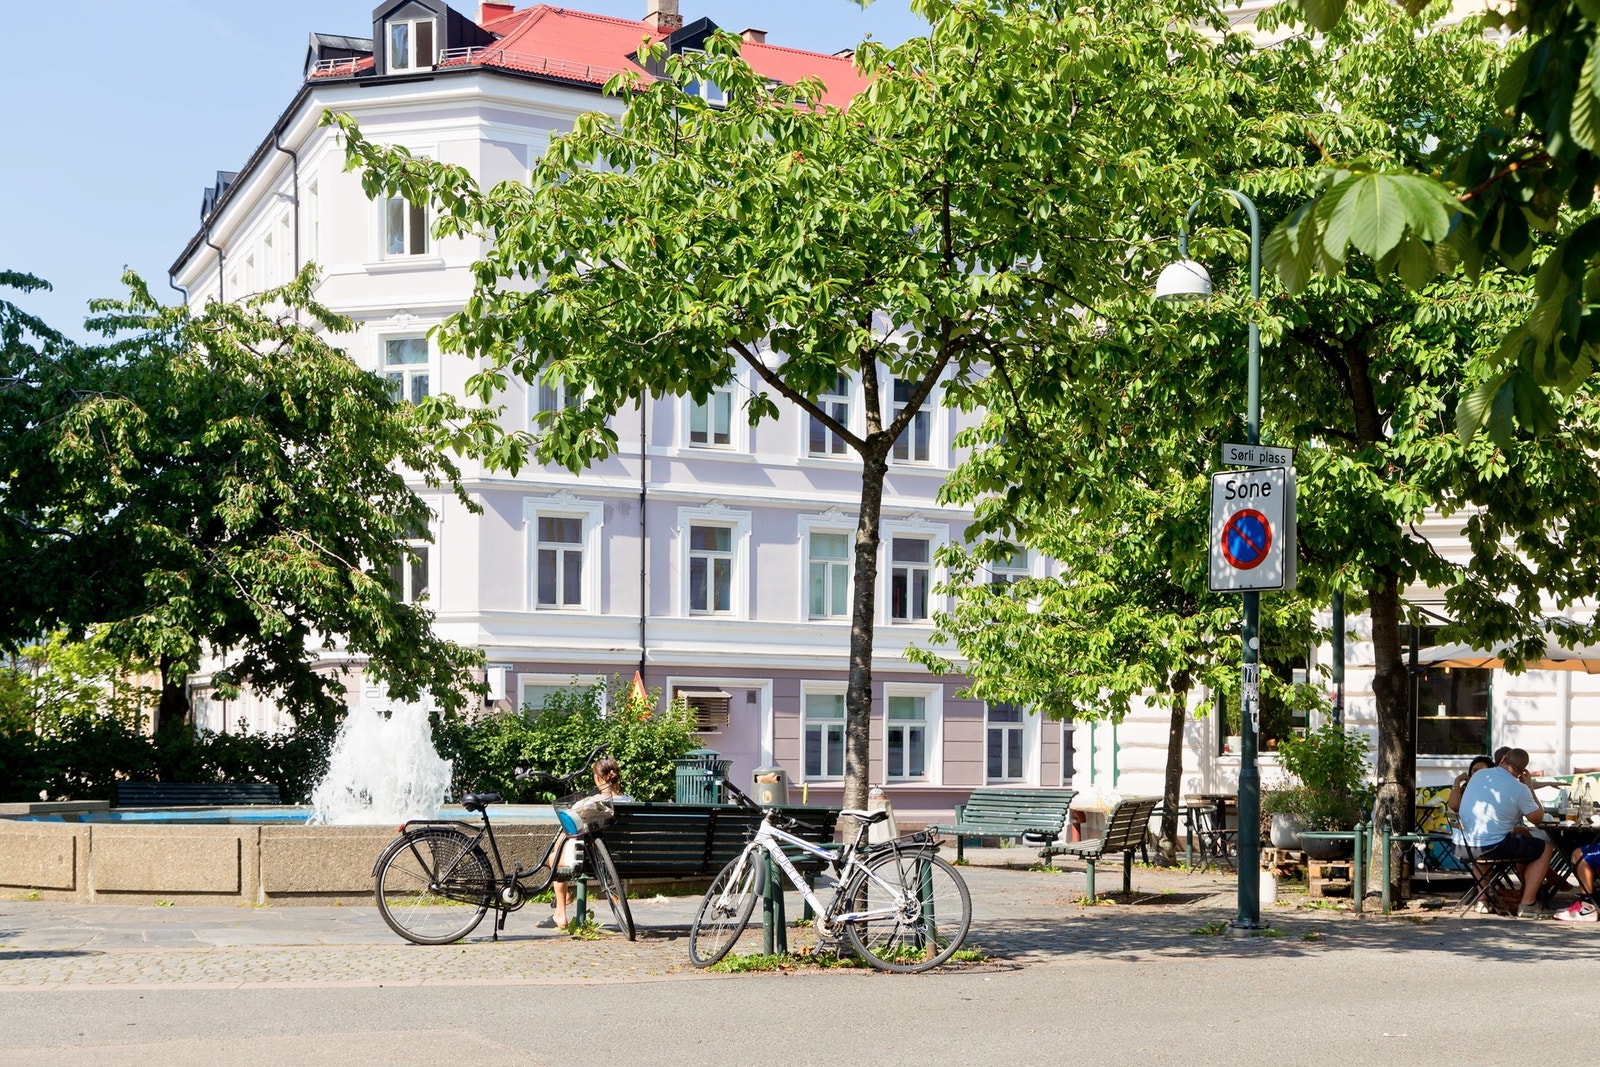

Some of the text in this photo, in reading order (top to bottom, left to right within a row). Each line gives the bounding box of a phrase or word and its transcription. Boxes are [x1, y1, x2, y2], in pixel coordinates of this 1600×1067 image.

[1230, 448, 1286, 465] Sørli plass
[1224, 480, 1272, 500] Sone
